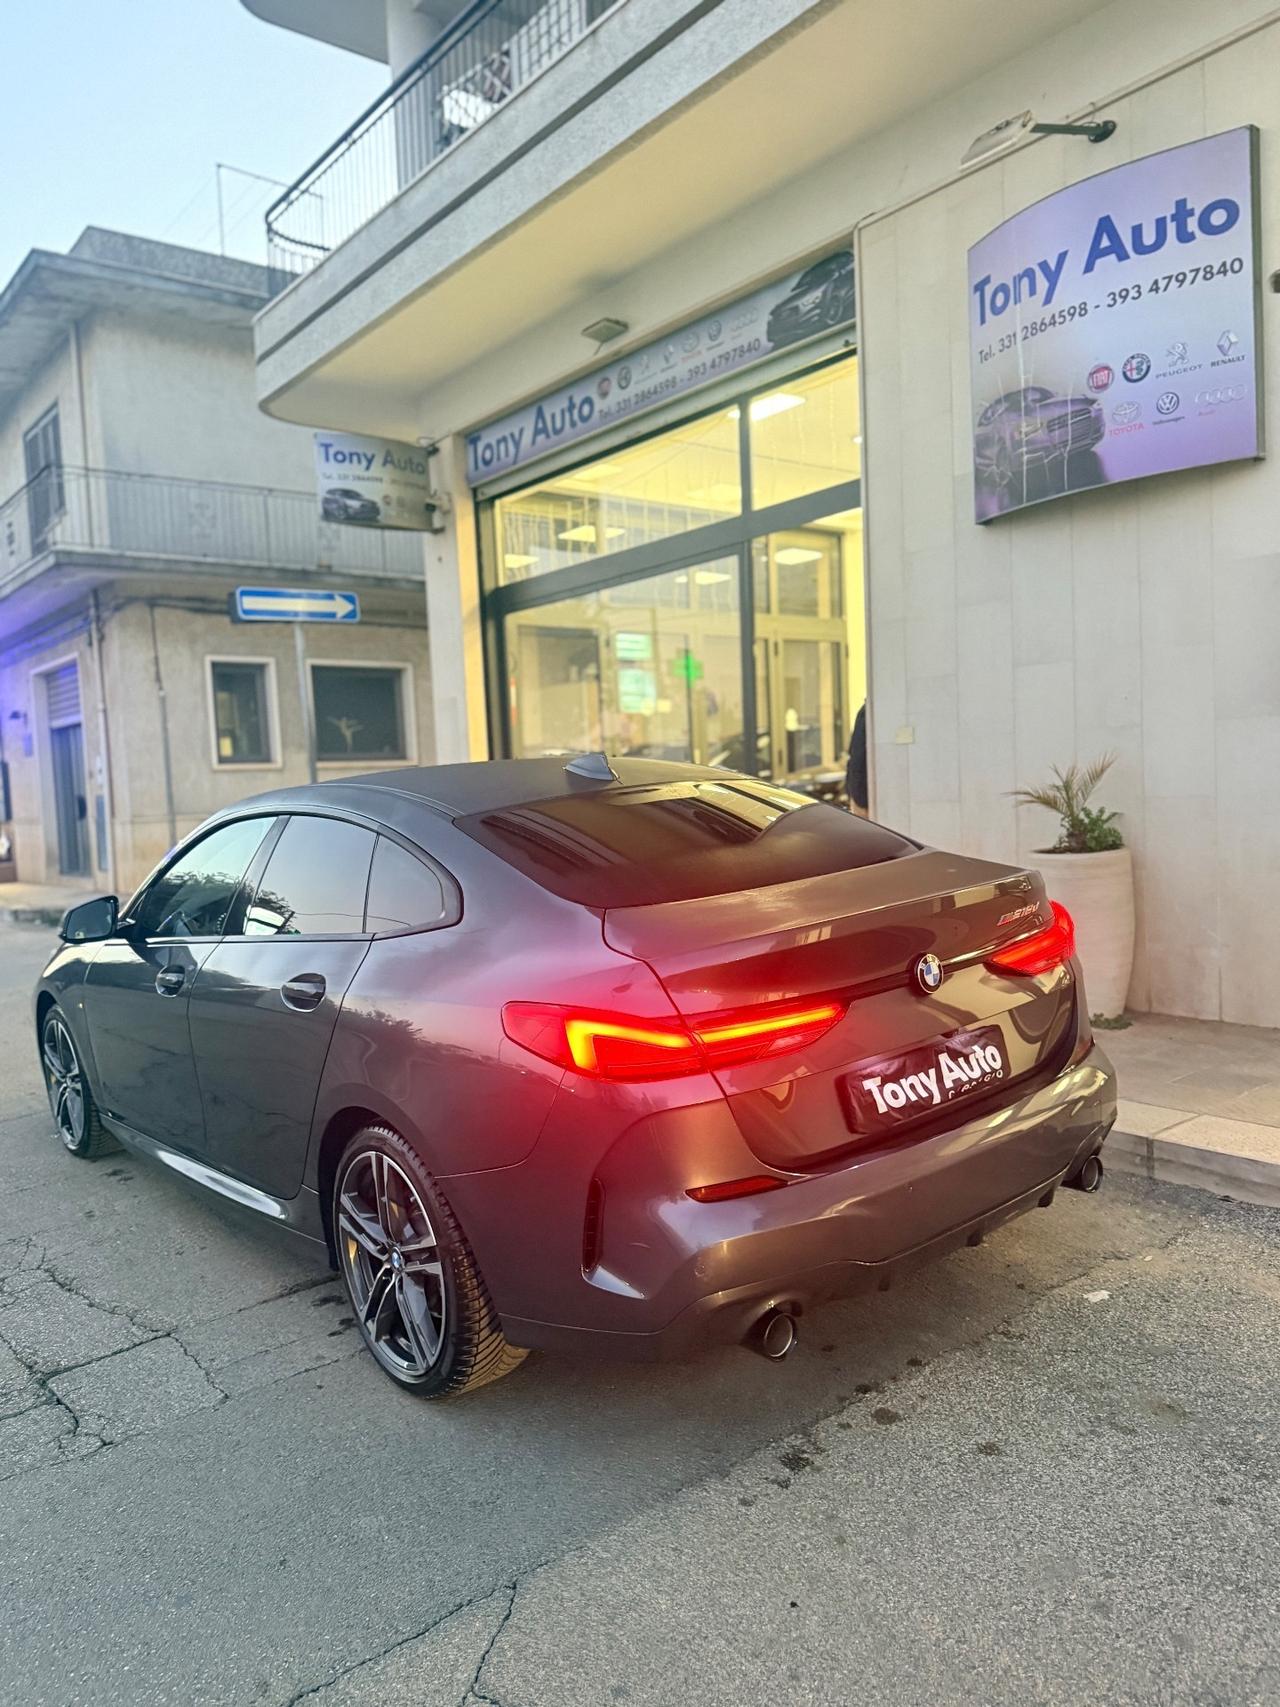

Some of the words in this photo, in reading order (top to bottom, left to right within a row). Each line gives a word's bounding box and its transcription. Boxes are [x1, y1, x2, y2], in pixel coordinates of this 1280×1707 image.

[973, 249, 1069, 326] Tony
[1082, 197, 1240, 275] Auto
[978, 349, 995, 364] Tel.
[999, 332, 1017, 353] 331
[1021, 302, 1088, 342] 2864598
[1107, 284, 1142, 309] 393
[1148, 257, 1244, 295] 4797840
[1155, 363, 1203, 379] PEUGEOT
[1210, 354, 1246, 368] RENAULT
[469, 433, 524, 471] Tony
[531, 395, 594, 447] Auto
[1108, 422, 1145, 436] TOYOTA
[320, 442, 376, 471] Tony
[382, 448, 426, 474] Auto
[862, 1066, 942, 1115] Tony
[938, 1045, 1002, 1089] Auto
